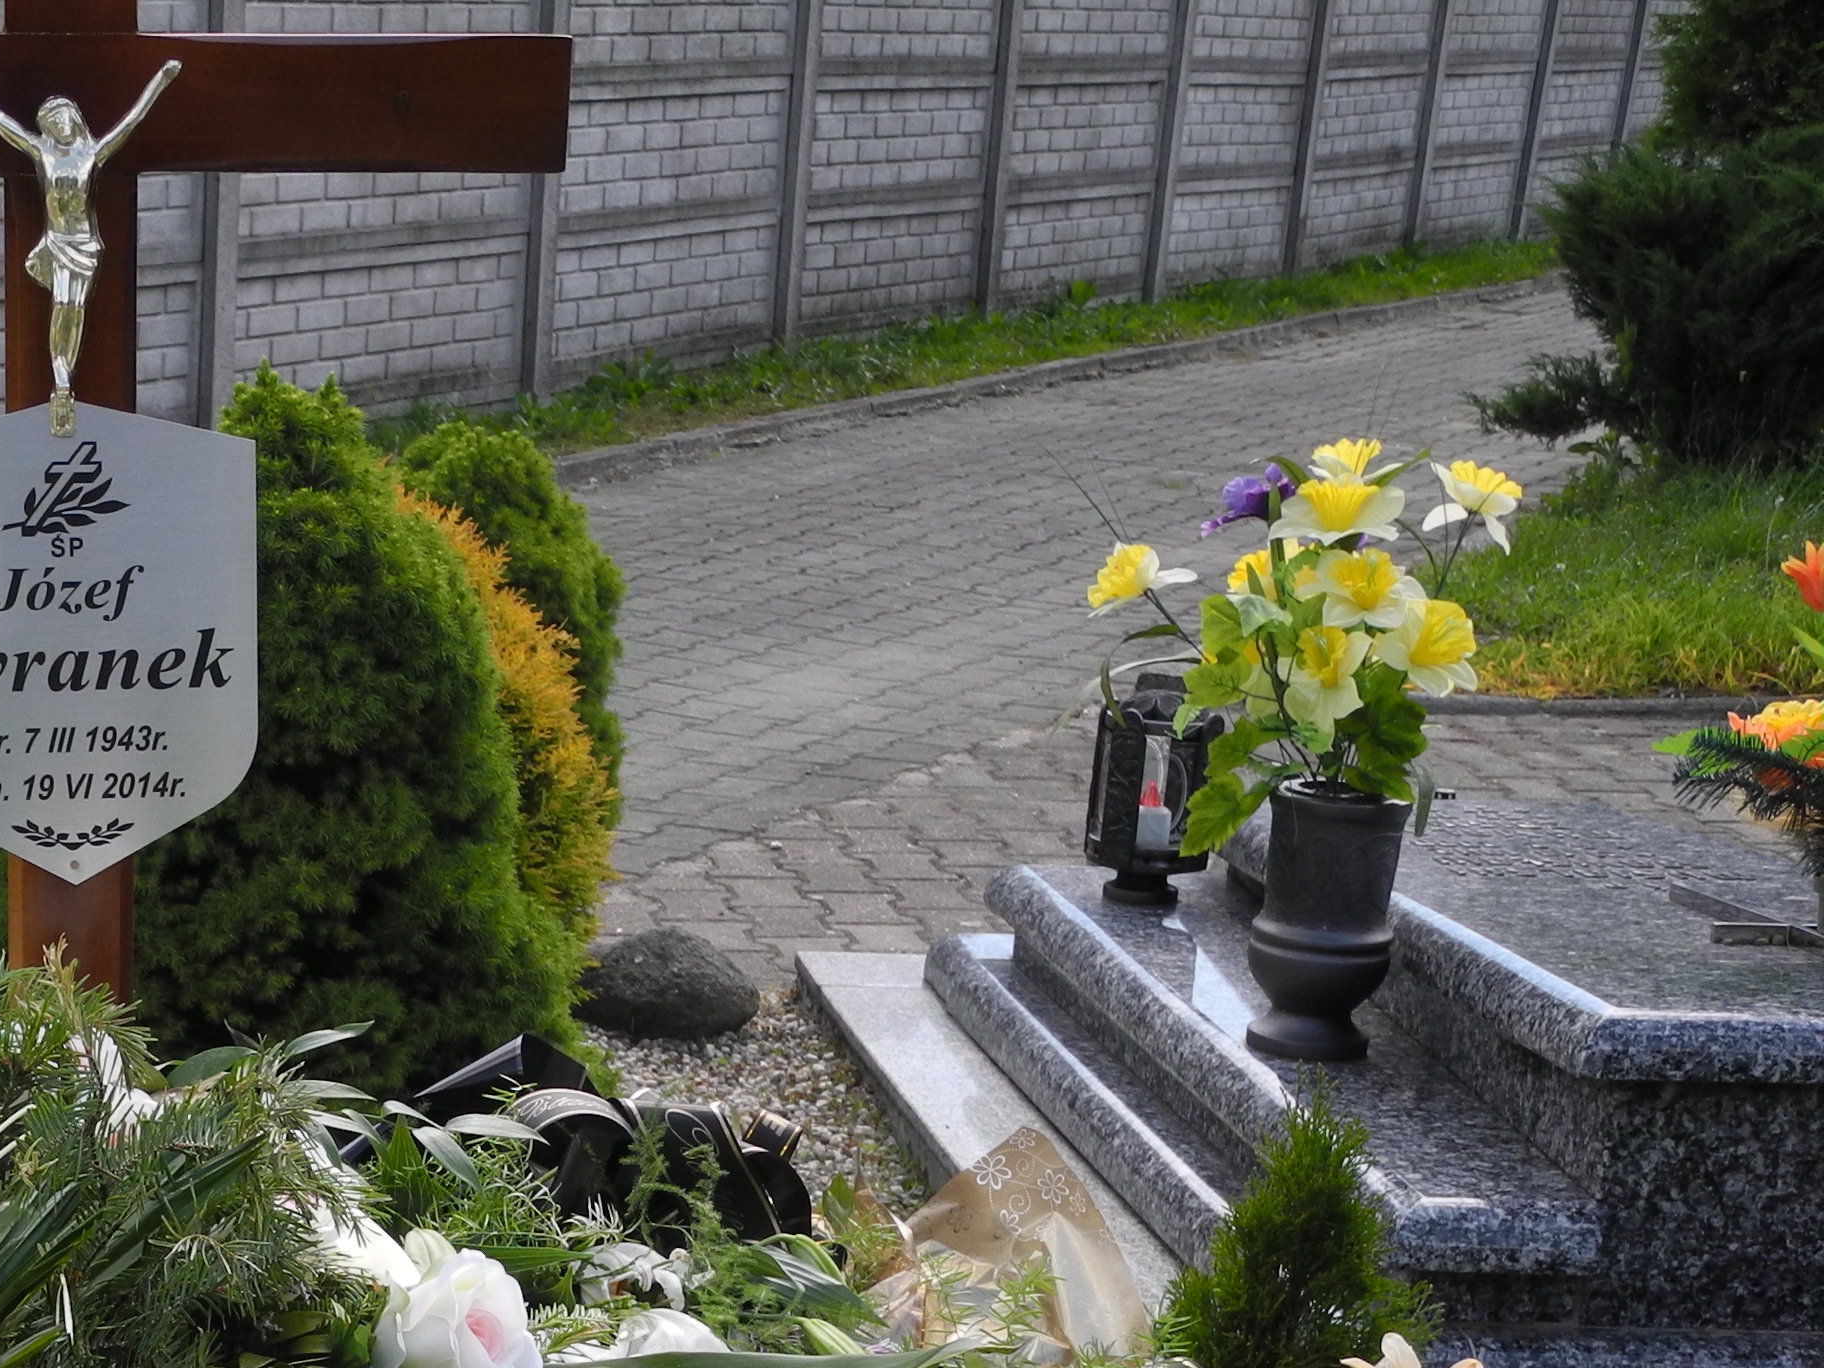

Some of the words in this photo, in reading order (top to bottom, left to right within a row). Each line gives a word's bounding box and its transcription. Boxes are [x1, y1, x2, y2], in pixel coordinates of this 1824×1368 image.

[24, 727, 42, 754] 7
[48, 726, 77, 754] III
[85, 725, 168, 753] 1943r.
[23, 773, 55, 801] 19
[65, 773, 94, 800] VI
[101, 771, 186, 799] 2014r.
